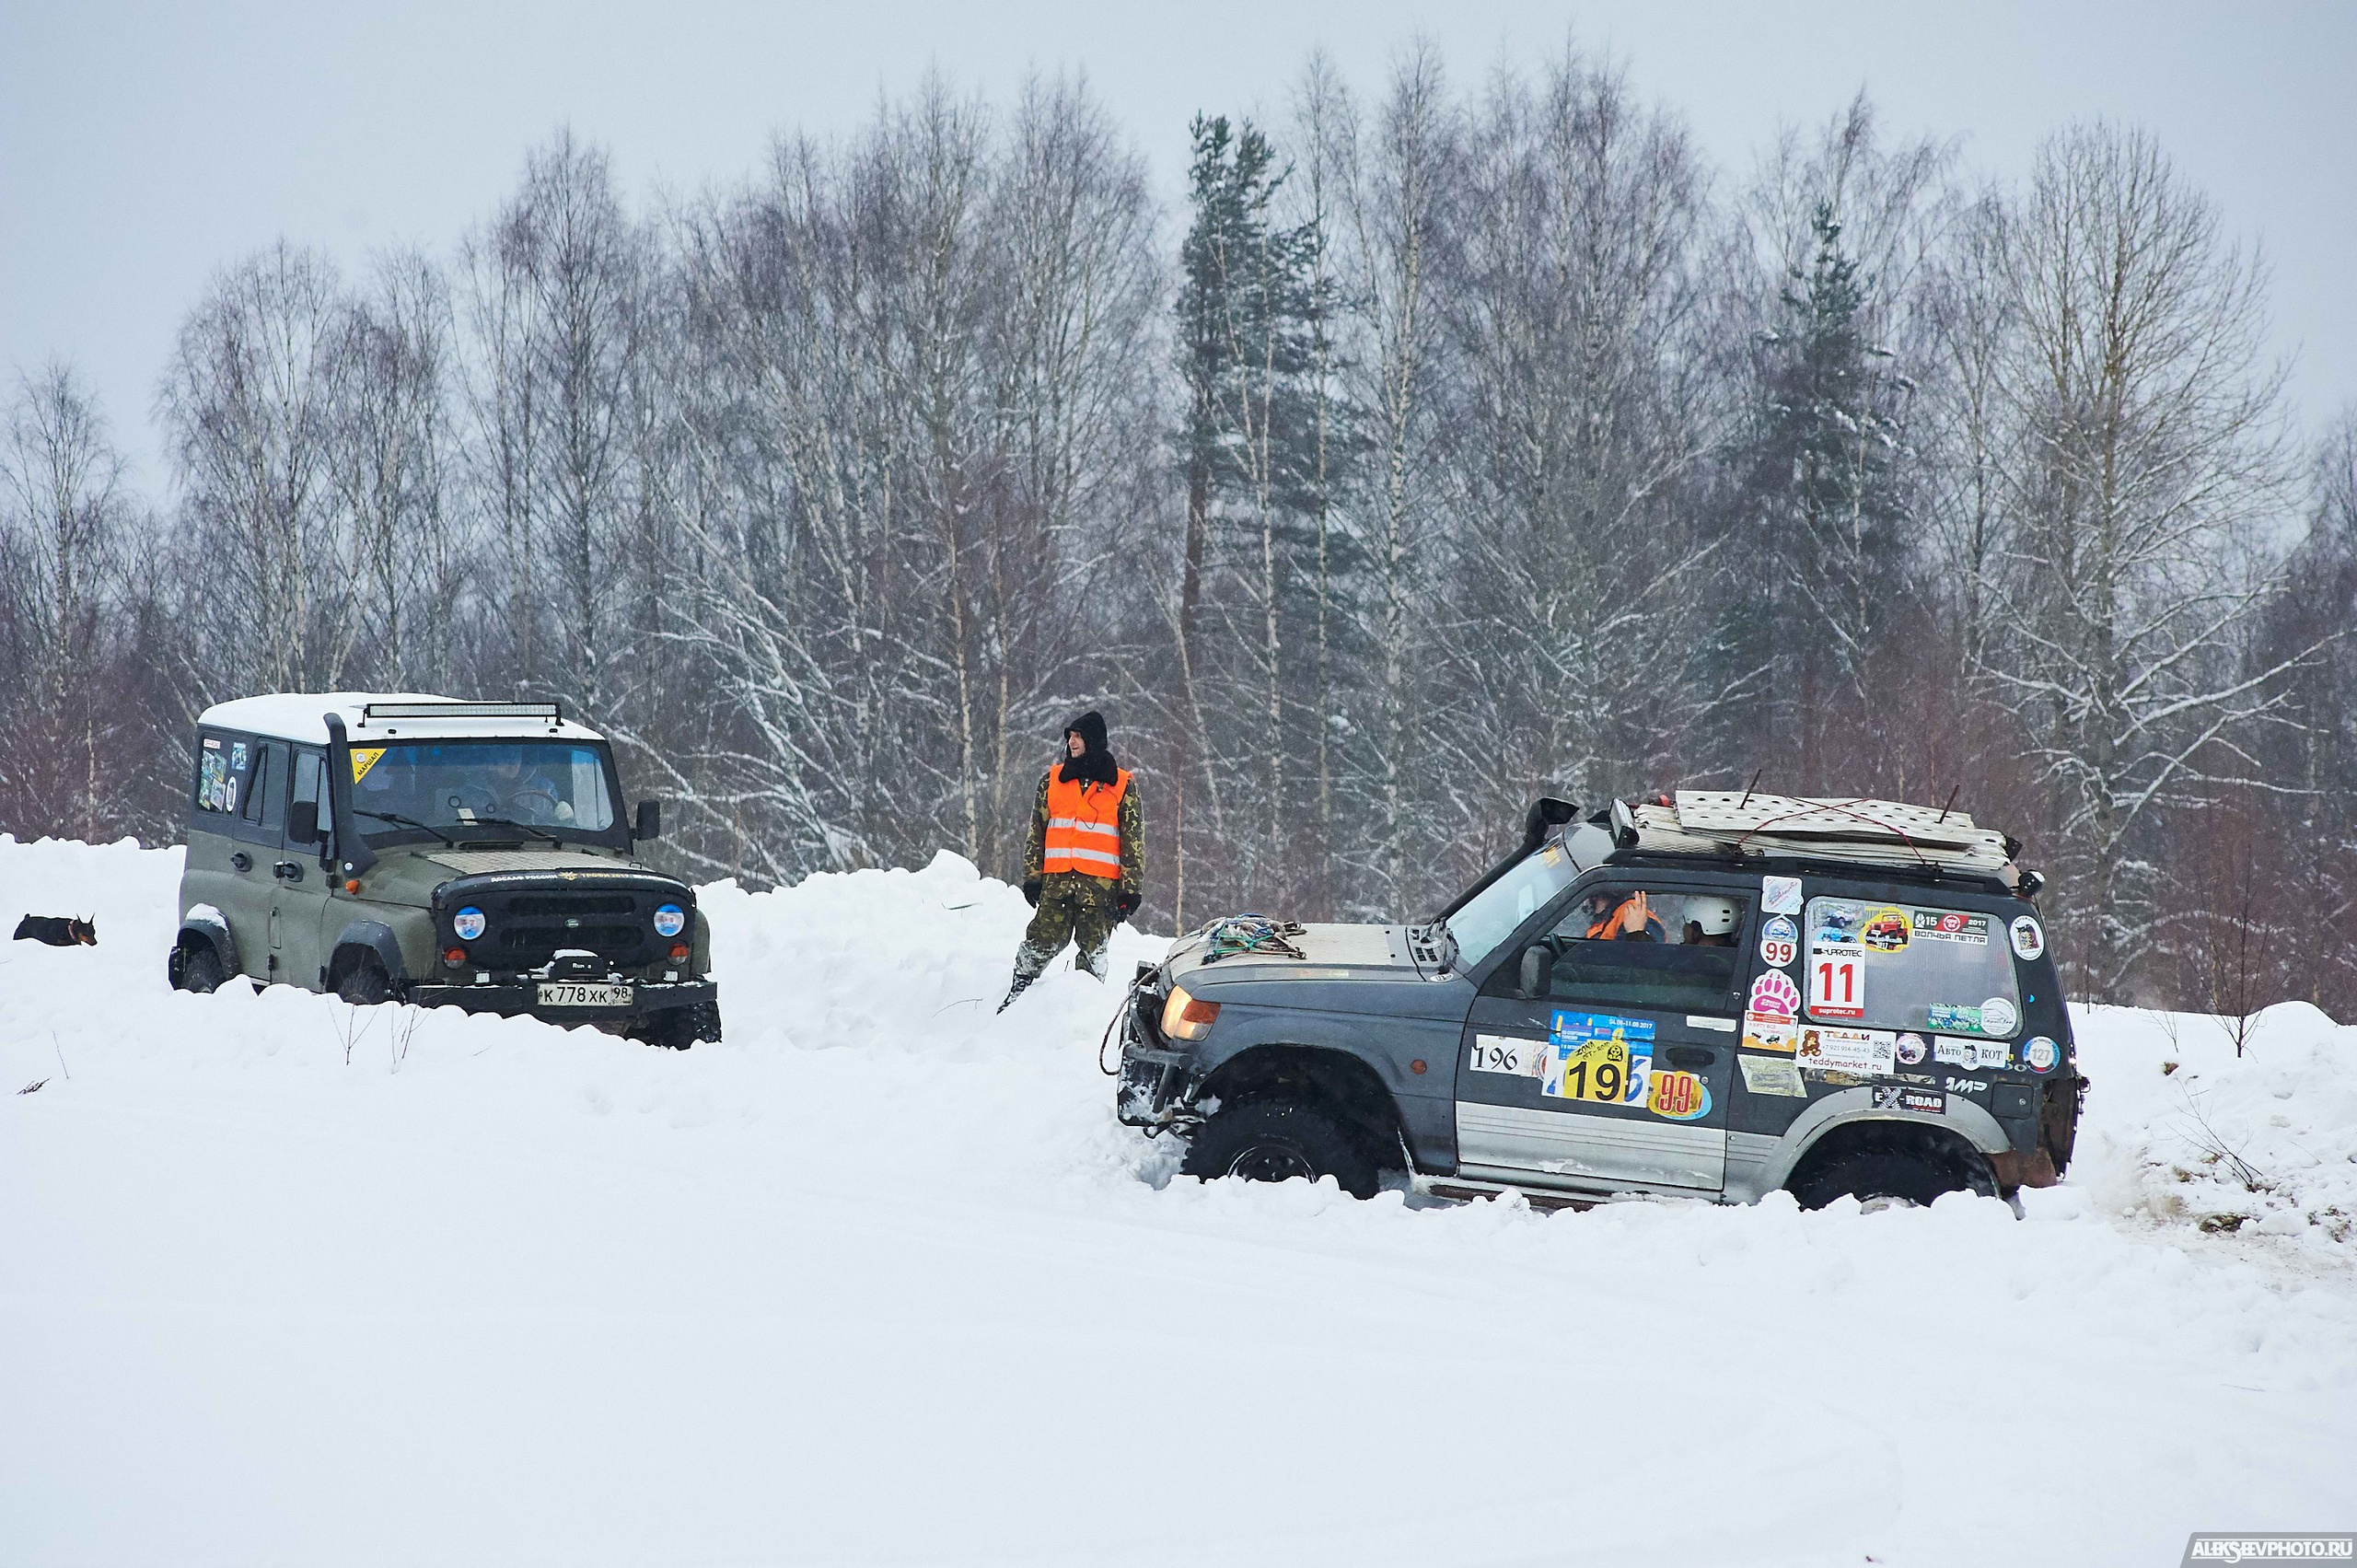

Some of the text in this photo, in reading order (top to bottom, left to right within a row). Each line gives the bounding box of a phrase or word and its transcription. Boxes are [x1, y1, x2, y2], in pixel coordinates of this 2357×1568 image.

[357, 752, 379, 775] МАРШАЛ
[1925, 915, 1938, 926] 15
[1968, 919, 1987, 927] 2017
[1914, 930, 1986, 944] ВОЛЧЬЯ ПЕТЛЯ
[1765, 942, 1793, 963] 99
[1820, 948, 1863, 958] SUPROTEC
[1818, 962, 1853, 1003] 11
[613, 986, 629, 999] 98
[1818, 1007, 1856, 1016] suprotec.ru
[1474, 1047, 1518, 1072] 196
[1937, 1044, 2003, 1061] Авто КОТ
[2031, 1049, 2050, 1063] 127
[1808, 1057, 1883, 1071] teddymarket.ru
[1568, 1061, 1620, 1101] 19
[1658, 1074, 1692, 1113] 99
